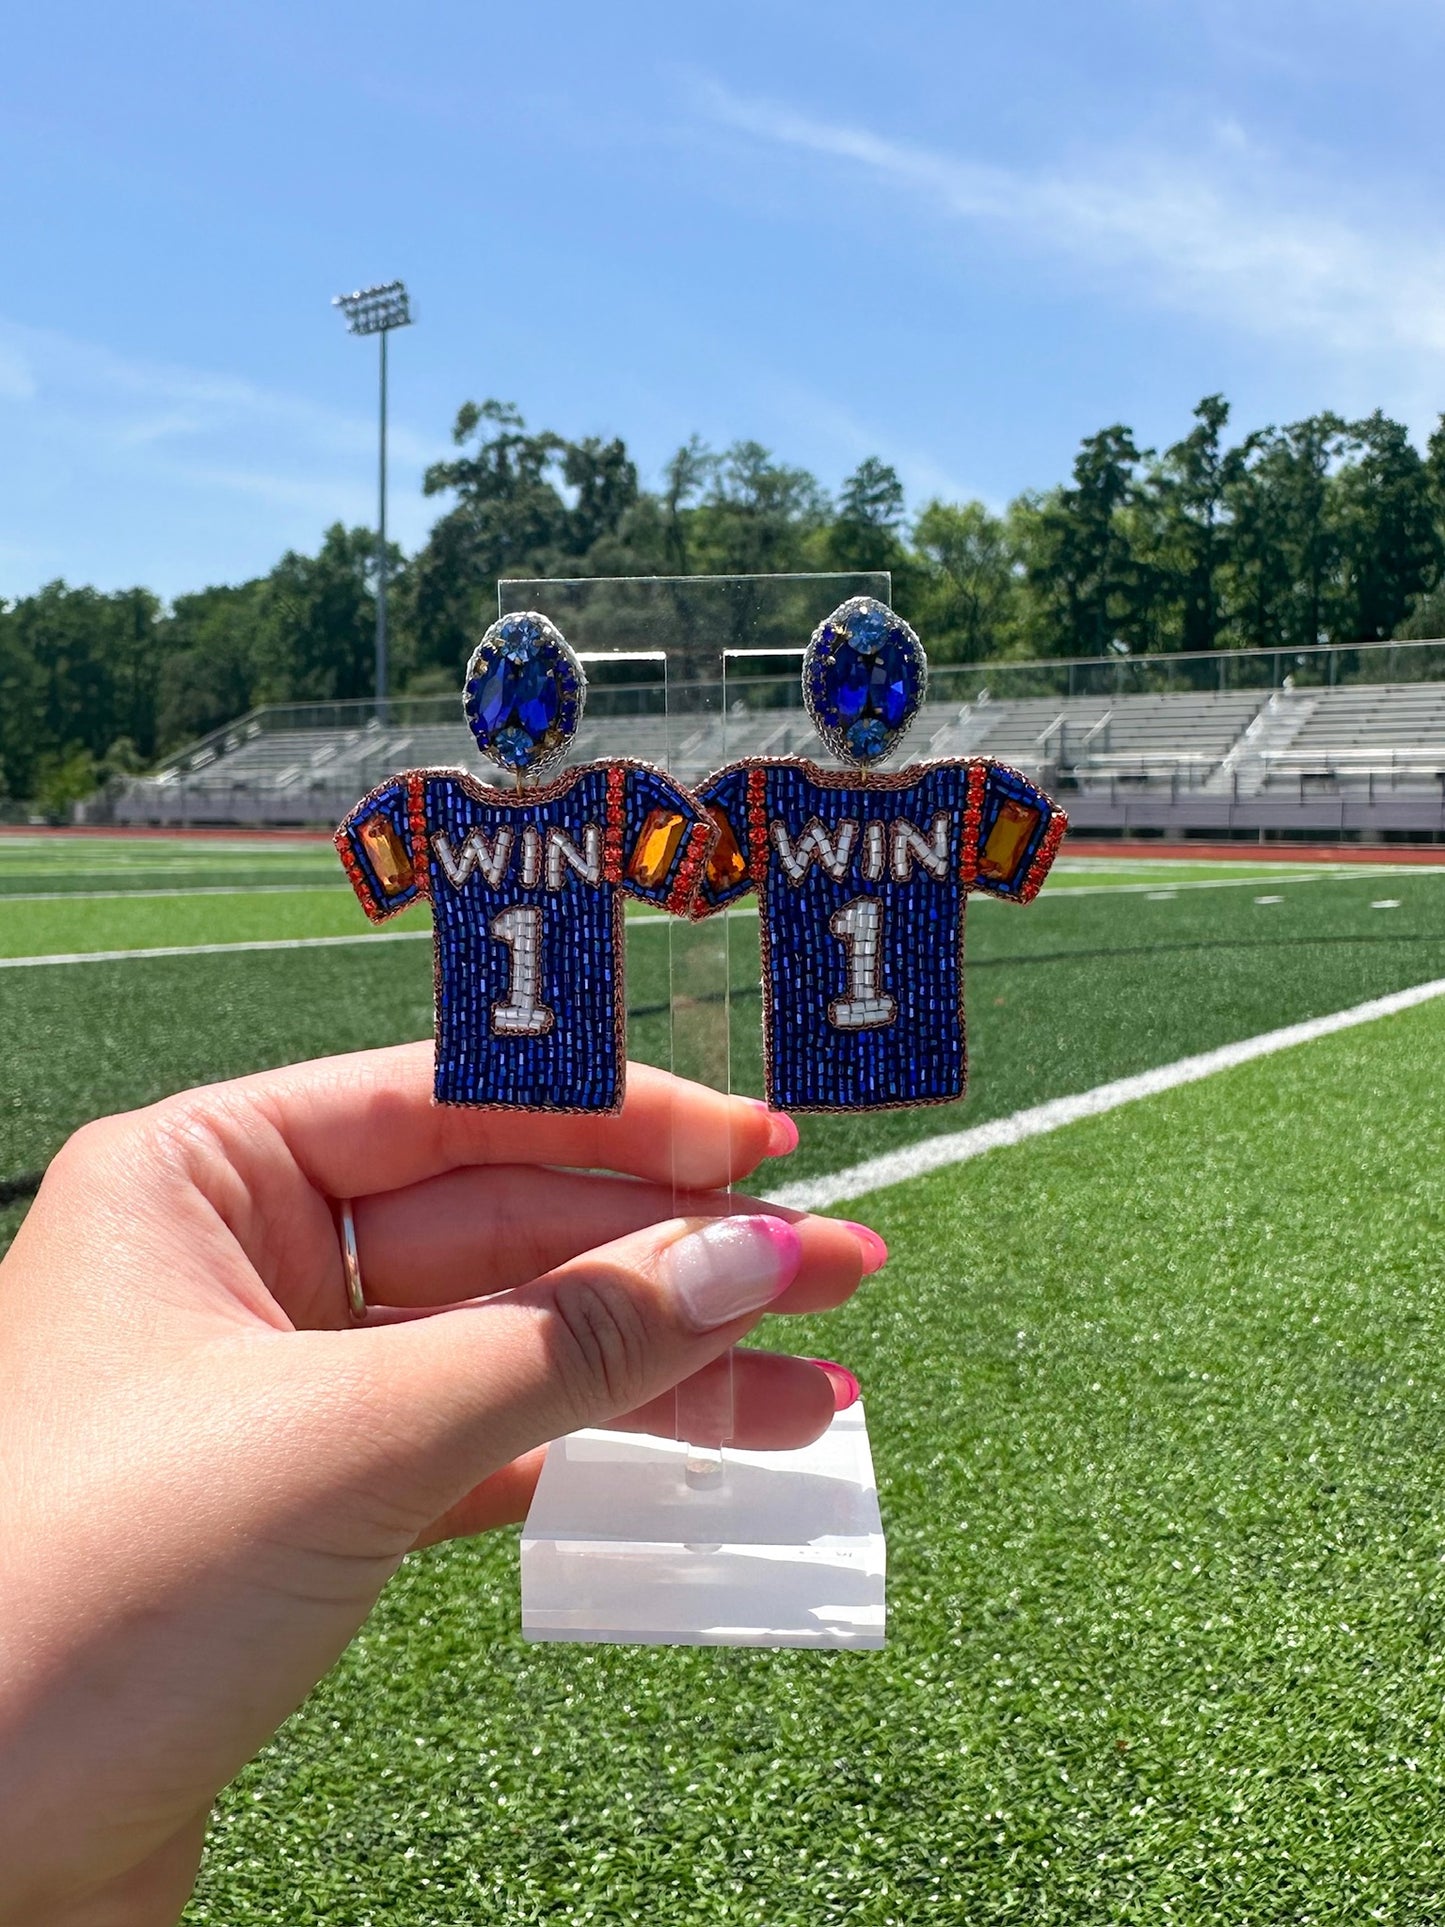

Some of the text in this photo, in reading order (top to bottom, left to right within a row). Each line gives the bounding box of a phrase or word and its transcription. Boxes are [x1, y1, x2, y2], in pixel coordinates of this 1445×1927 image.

[431, 823, 604, 890] WIN
[770, 810, 950, 888] WIN
[491, 904, 554, 1035] 1
[828, 895, 896, 1030] 1
